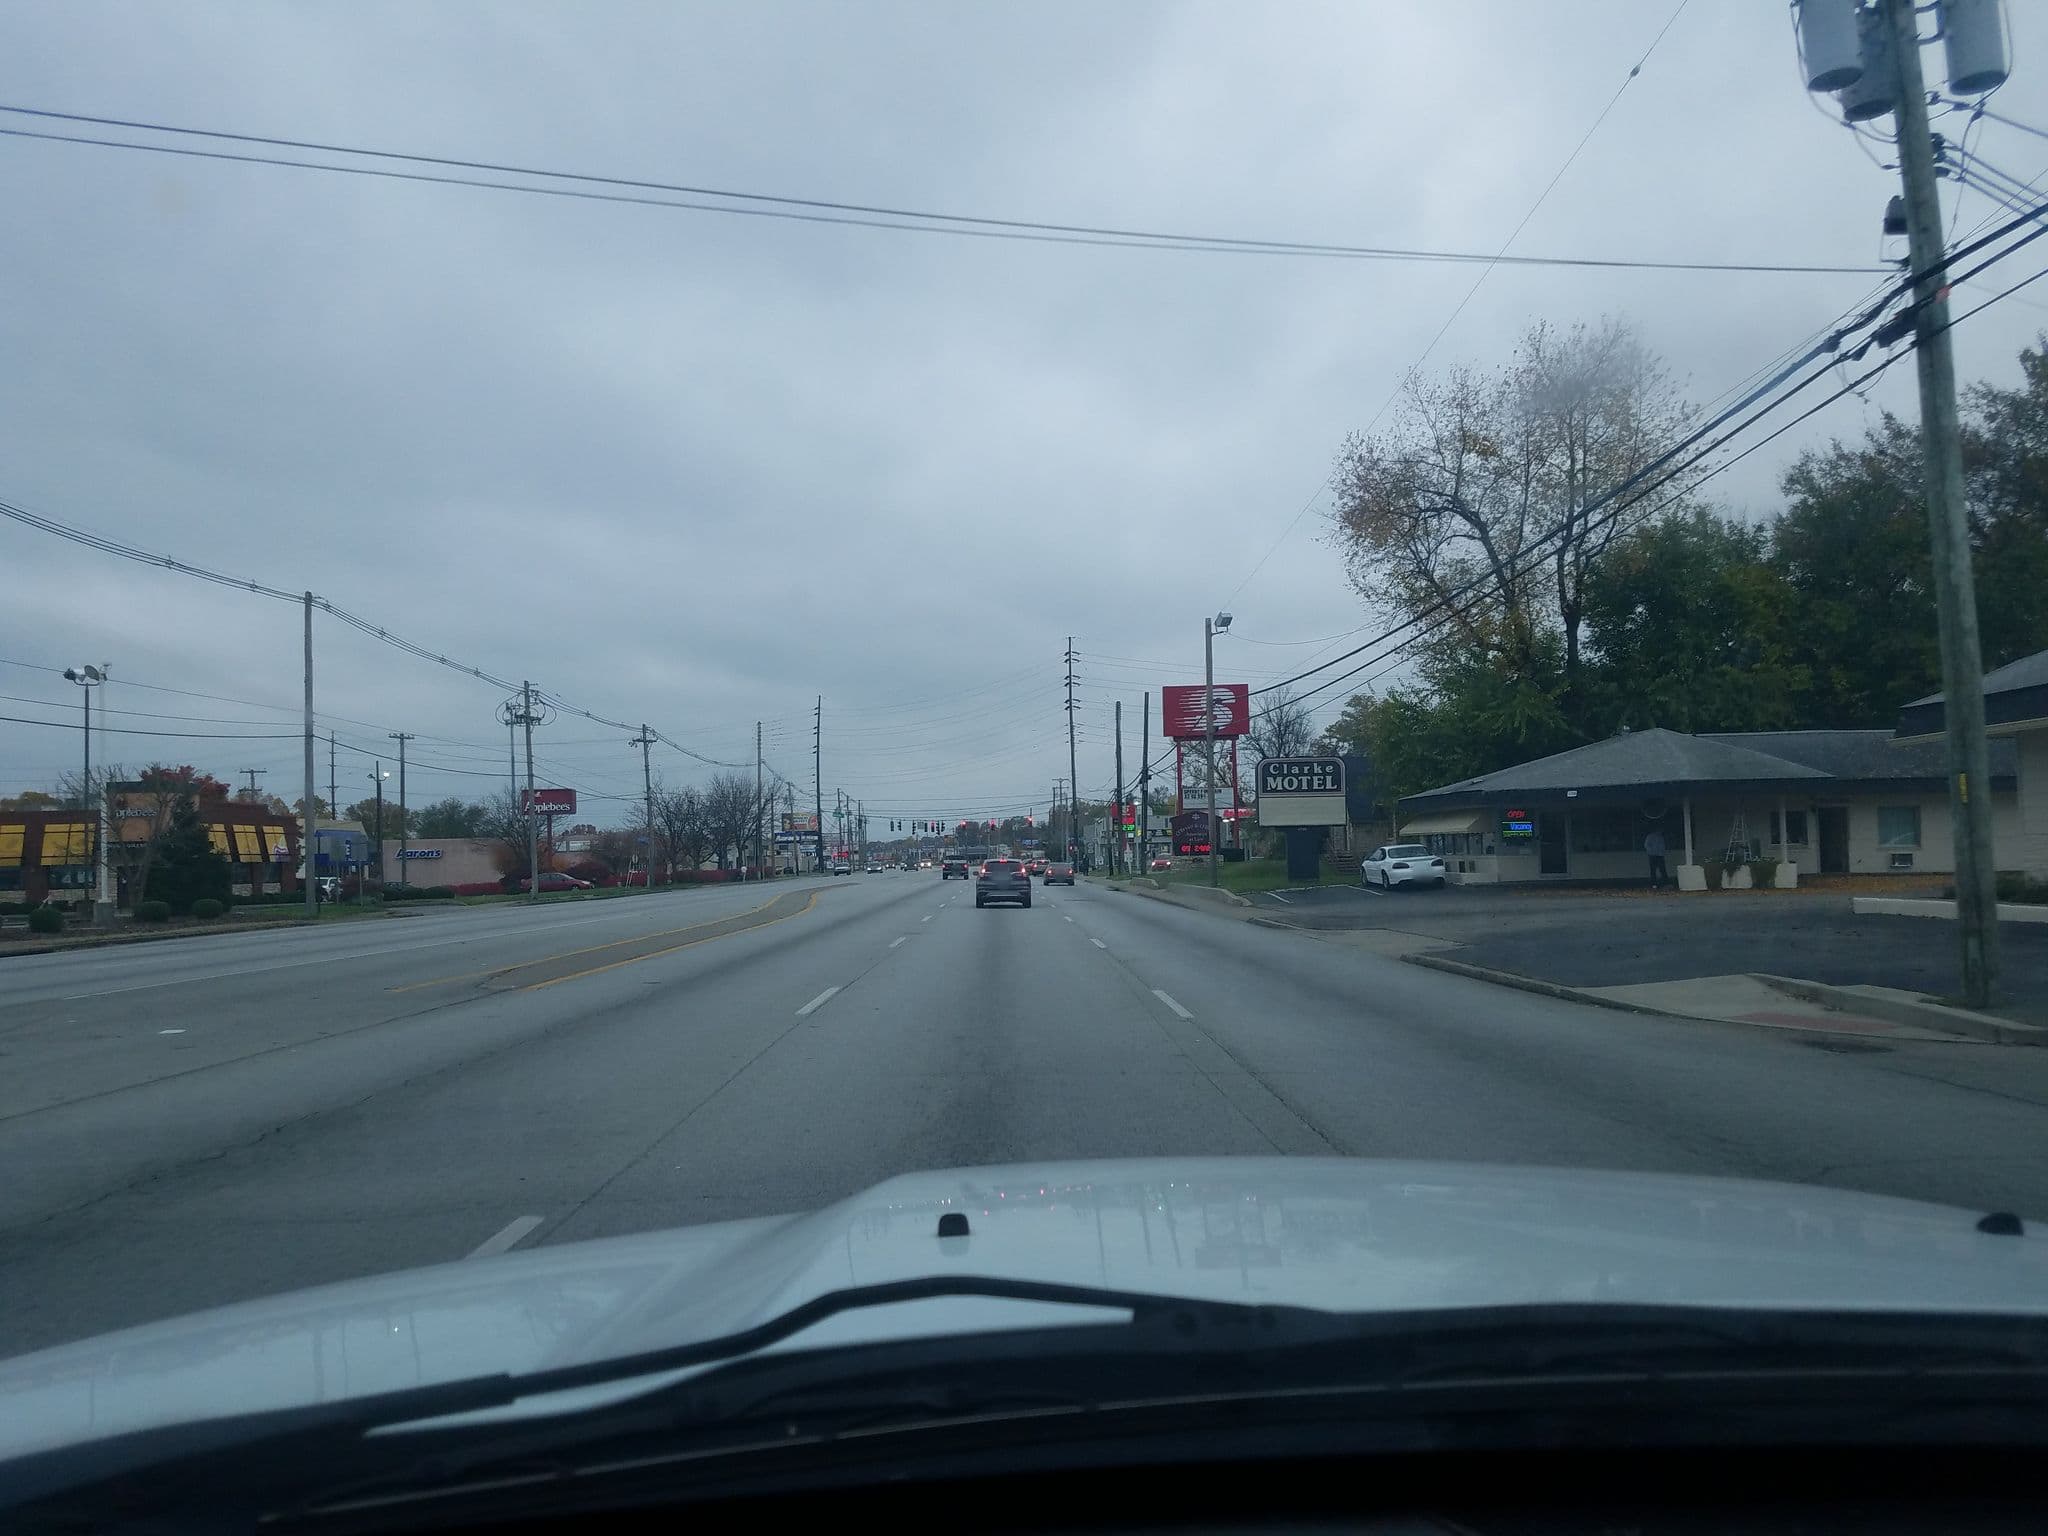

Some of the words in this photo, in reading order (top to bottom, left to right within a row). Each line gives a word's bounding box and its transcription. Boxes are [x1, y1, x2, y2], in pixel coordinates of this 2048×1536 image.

[1269, 763, 1334, 775] Clarke
[1266, 776, 1338, 791] MOTEL
[1511, 823, 1532, 833] Vacancy
